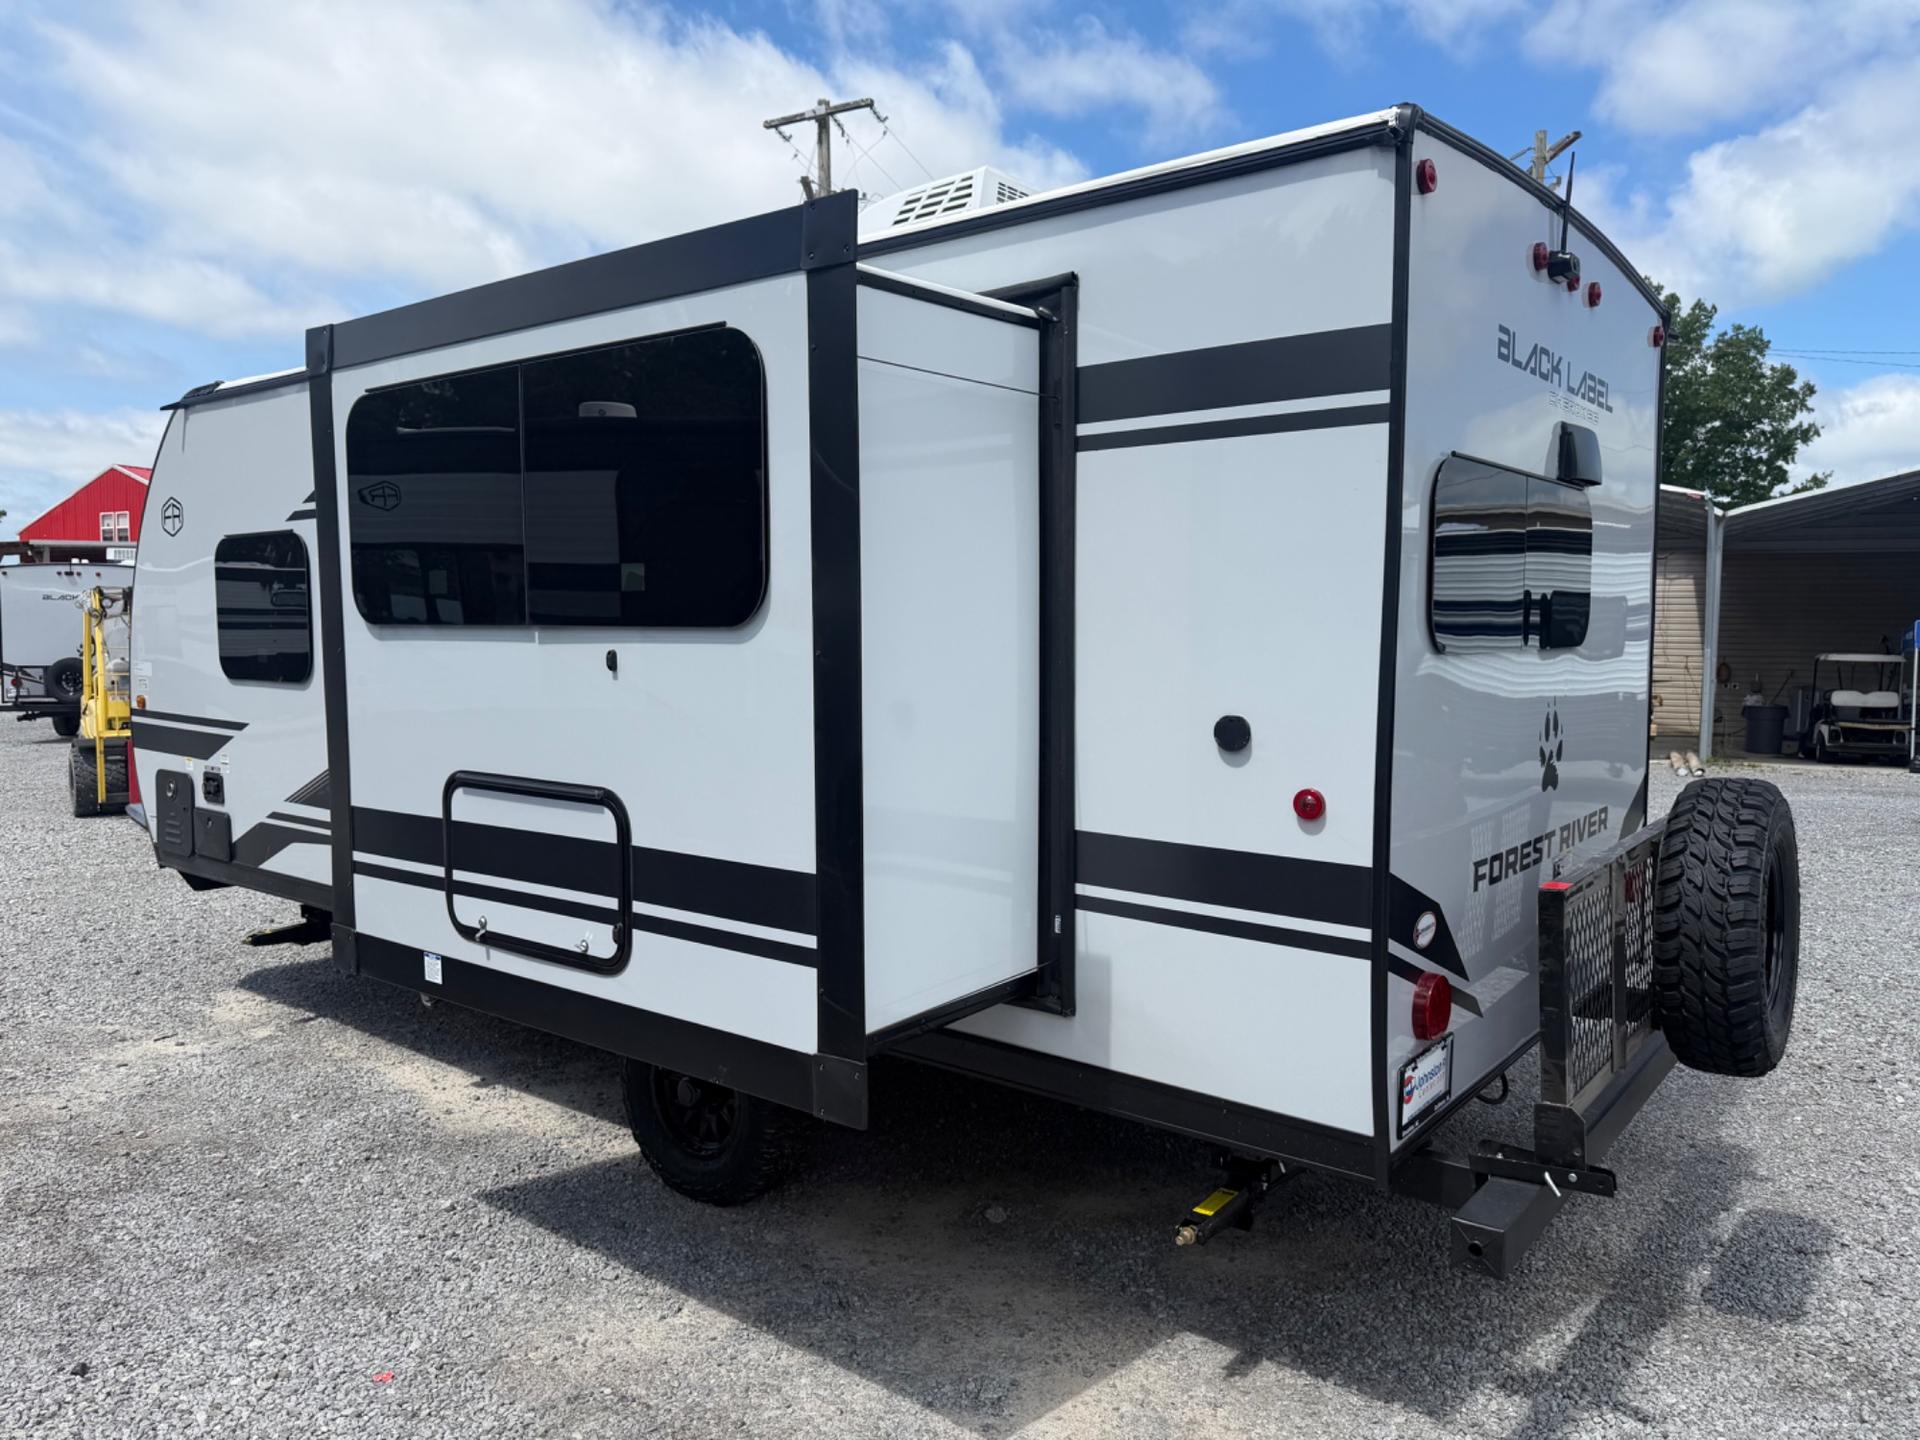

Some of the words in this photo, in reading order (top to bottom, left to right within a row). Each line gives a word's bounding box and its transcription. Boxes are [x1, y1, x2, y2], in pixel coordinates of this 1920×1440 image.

[1498, 323, 1563, 388] BLACK
[1567, 361, 1613, 413] LABEL
[1473, 829, 1556, 892] FOREST
[1560, 806, 1608, 854] RIVER
